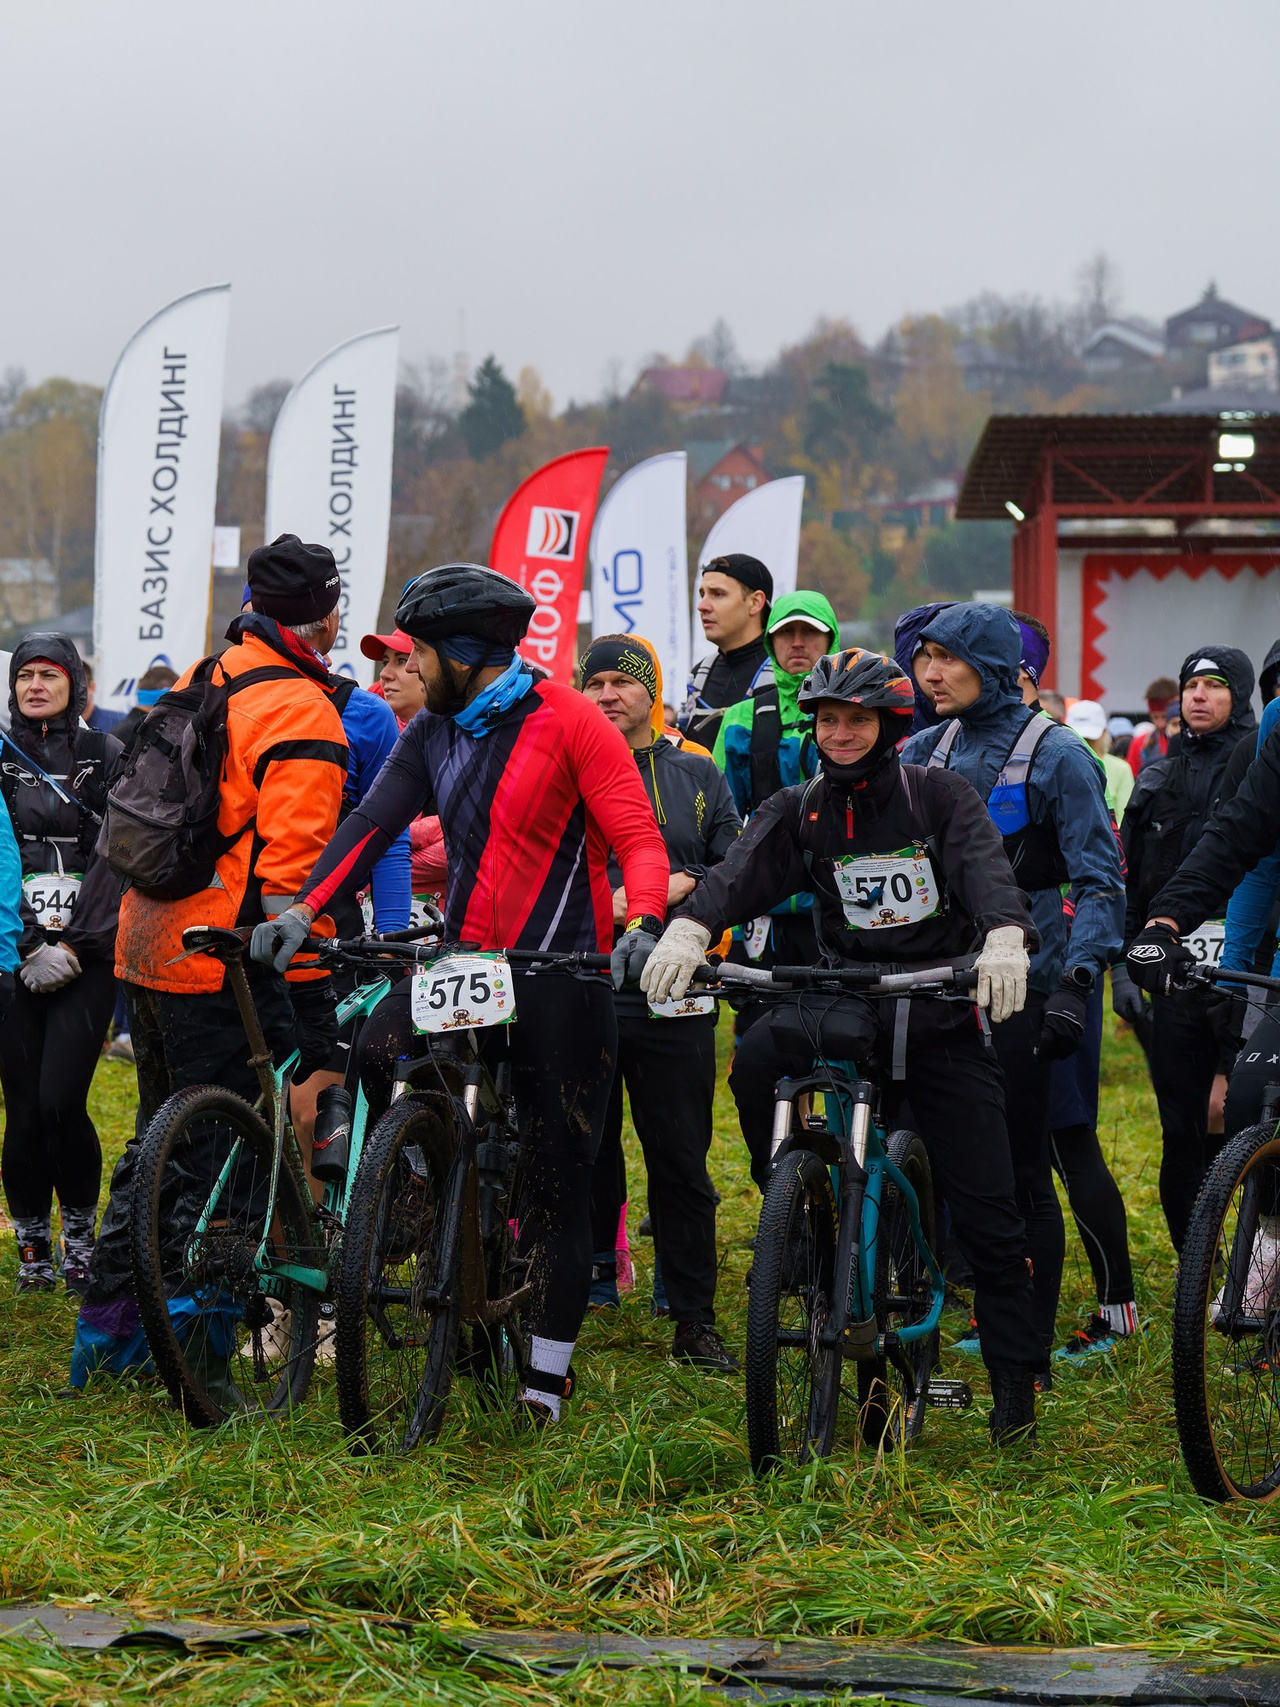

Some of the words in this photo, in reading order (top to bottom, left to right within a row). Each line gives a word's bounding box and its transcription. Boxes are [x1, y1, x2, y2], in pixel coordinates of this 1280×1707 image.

[148, 346, 190, 516] ХОЛДИНГ
[328, 383, 359, 537] ХОЛДИНГ
[139, 526, 173, 641] БАЗИС
[31, 889, 77, 915] 544
[855, 872, 913, 906] 570
[428, 972, 491, 1010] 575
